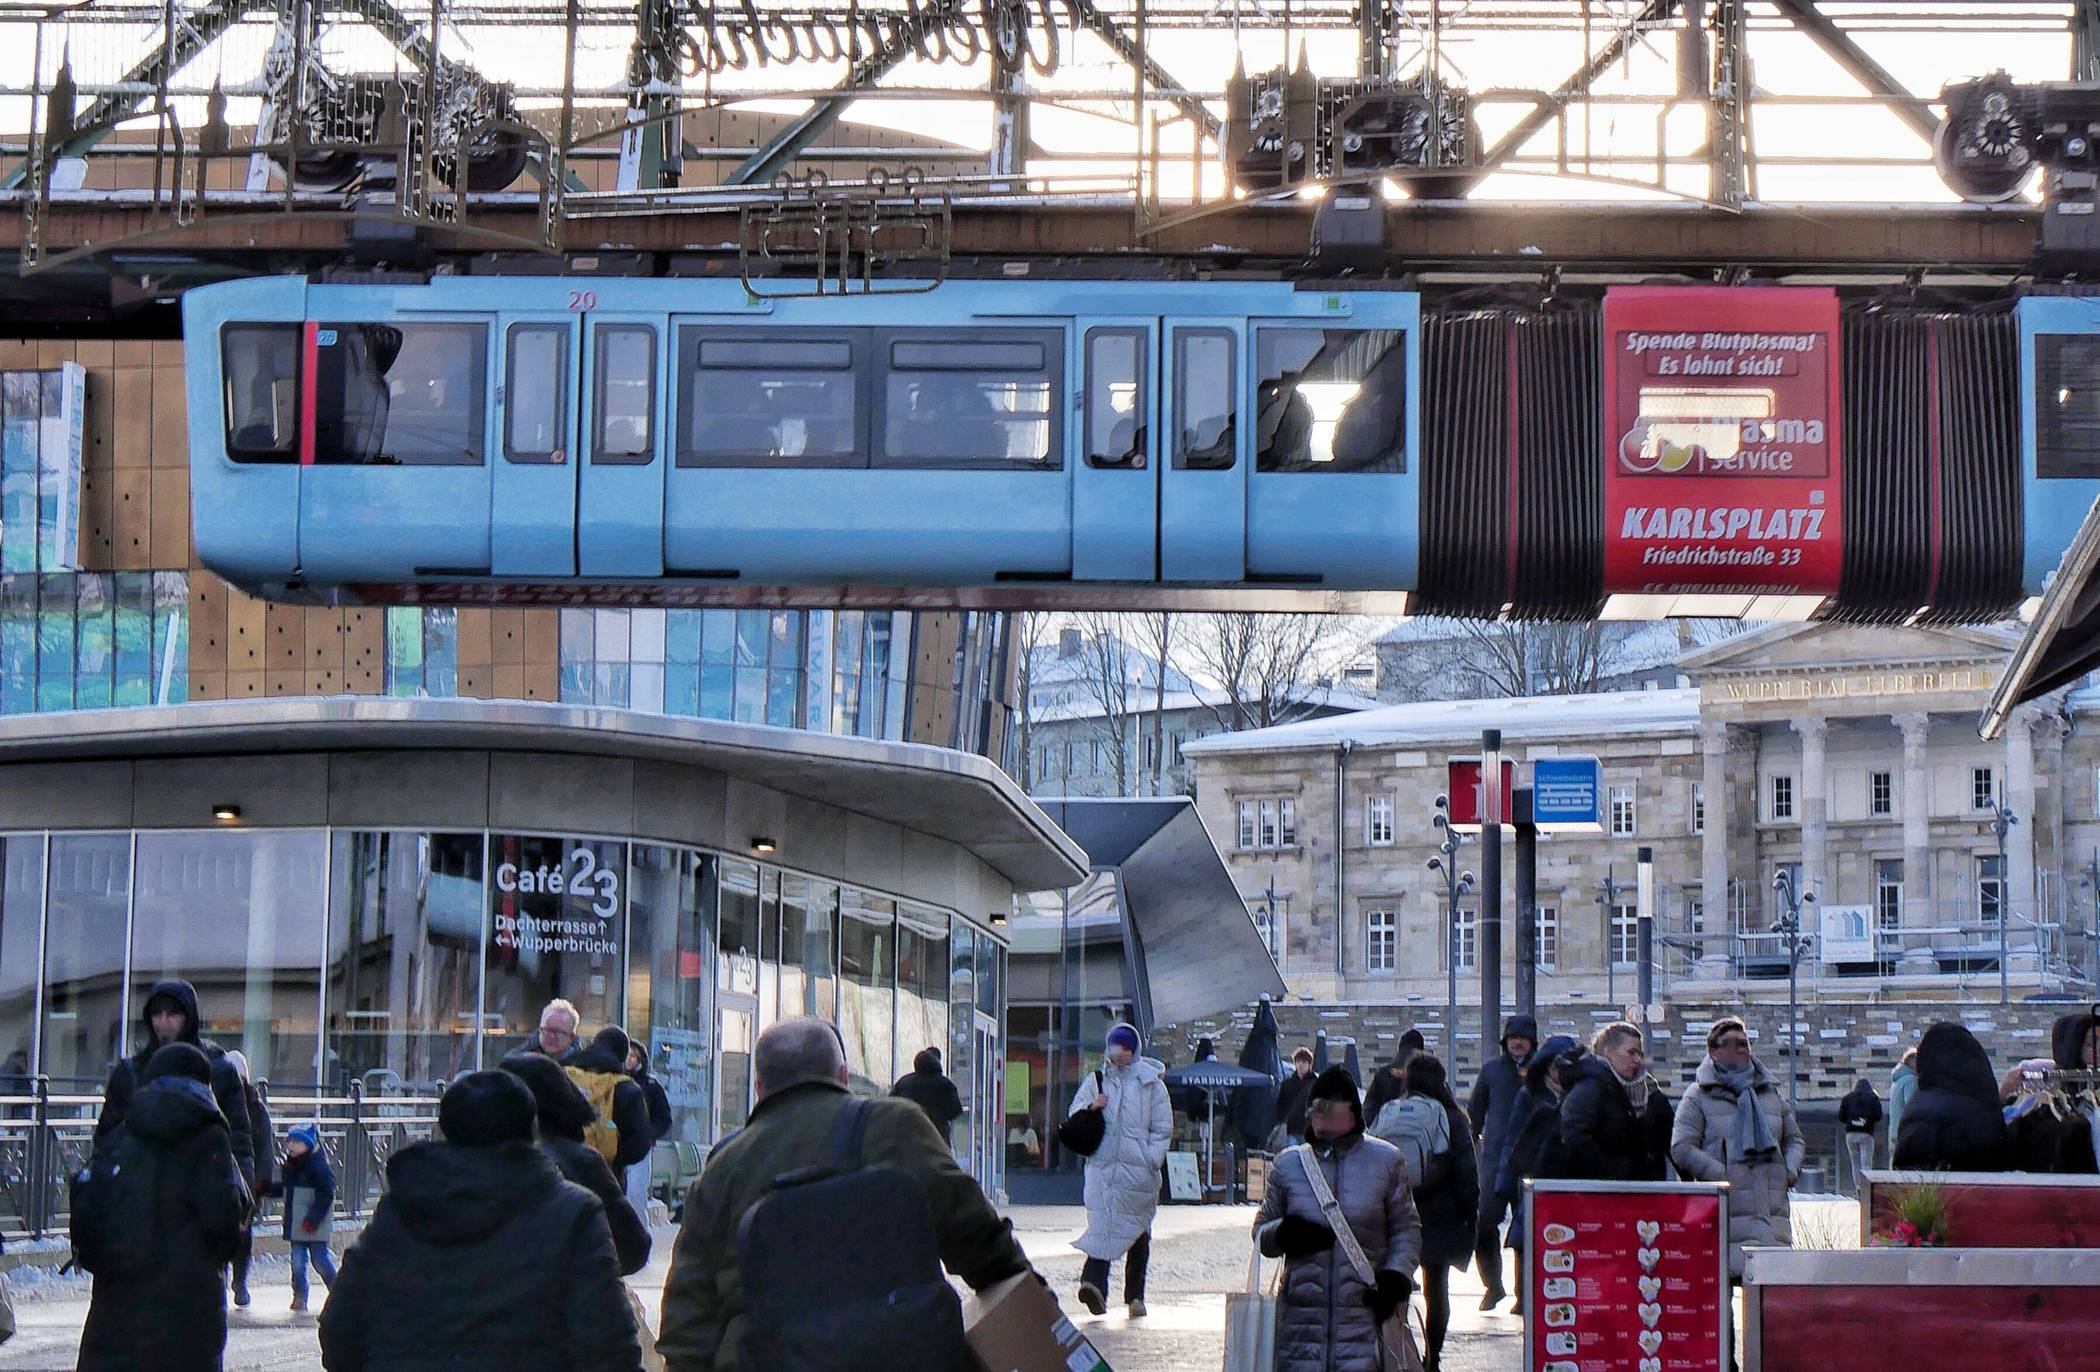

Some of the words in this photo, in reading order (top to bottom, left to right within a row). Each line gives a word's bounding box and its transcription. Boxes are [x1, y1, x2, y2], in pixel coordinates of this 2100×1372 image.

[568, 291, 598, 310] 20
[1625, 332, 1696, 354] Spende
[1701, 333, 1816, 355] Blutplasma!
[1658, 355, 1678, 375] Es
[1684, 354, 1733, 375] lohnt
[1738, 355, 1784, 375] sich!
[1621, 507, 1825, 540] KARLSPLATZ
[1643, 546, 1775, 566] Friedrichstraße
[1778, 548, 1802, 565] 33
[496, 863, 564, 894] Café
[569, 848, 618, 918] 23
[495, 914, 596, 936] Dachterrasse
[511, 933, 618, 955] Wupperbrücke
